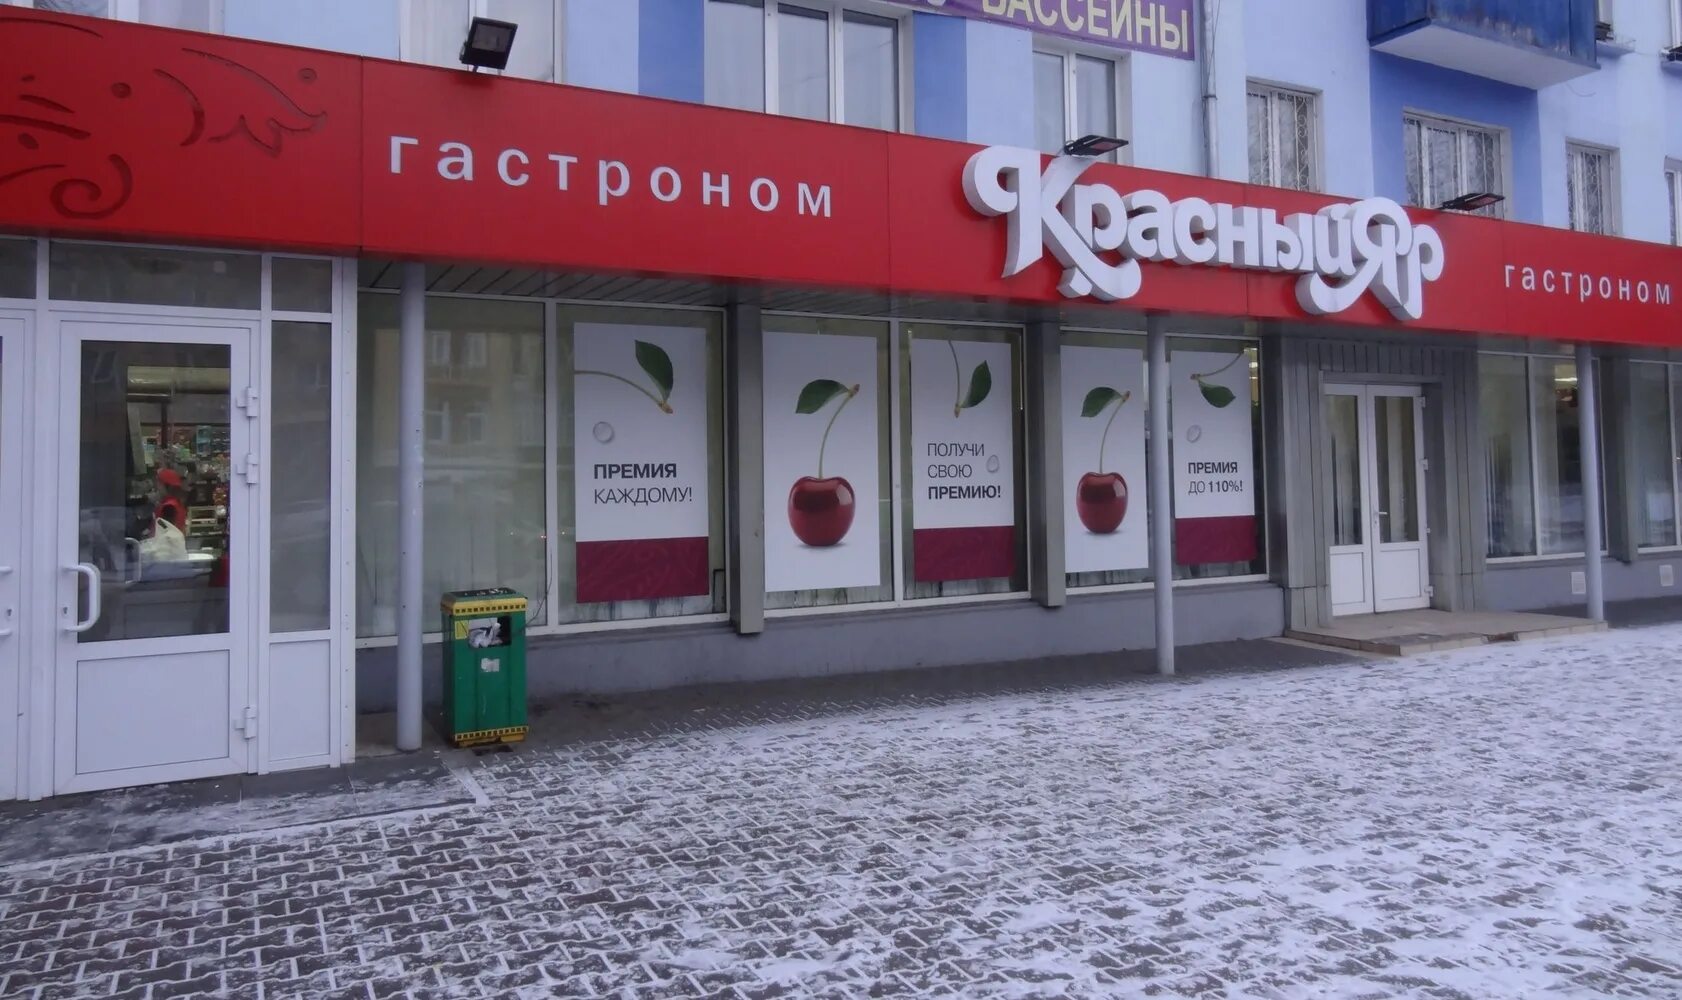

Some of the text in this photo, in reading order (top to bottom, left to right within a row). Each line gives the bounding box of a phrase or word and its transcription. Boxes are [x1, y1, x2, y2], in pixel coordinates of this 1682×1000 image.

[389, 135, 832, 218] гастроном
[961, 145, 1446, 321] Красный Яр
[1504, 263, 1672, 305] гастроном
[927, 443, 985, 457] ПОЛУЧИ
[593, 463, 677, 479] ПРЕМИЯ
[927, 465, 973, 479] СВОЮ
[1188, 462, 1238, 474] ПРЕМИЯ
[927, 485, 1001, 500] ПРЕМИЮ!
[1188, 480, 1243, 495] ДО 110%!
[593, 487, 693, 506] КАЖДОМУ!
